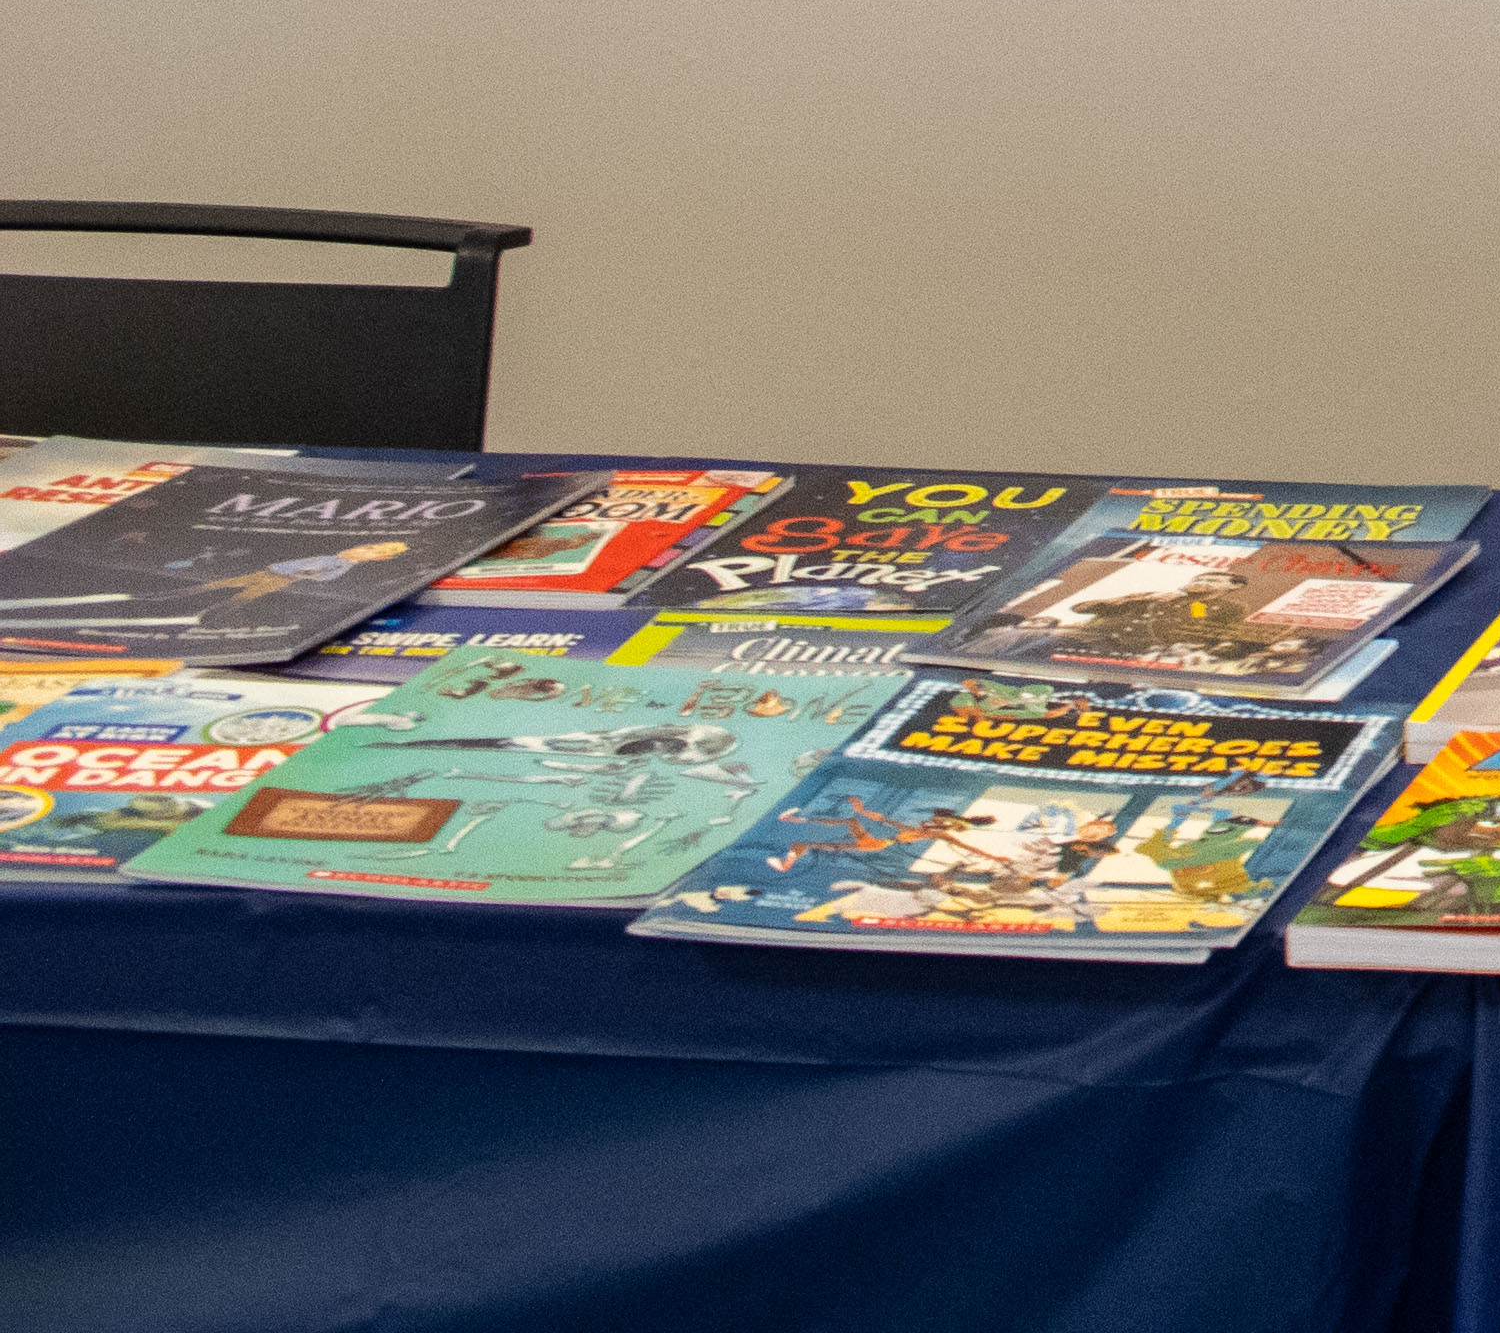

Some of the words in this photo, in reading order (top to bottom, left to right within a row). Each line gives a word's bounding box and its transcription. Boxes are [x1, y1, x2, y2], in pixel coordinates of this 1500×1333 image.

[205, 493, 487, 521] MARIO
[847, 480, 1067, 510] YOU
[856, 507, 991, 524] CAN
[1142, 498, 1423, 521] SPENDING
[1129, 514, 1415, 542] MONEY
[831, 549, 932, 564] THE
[932, 713, 1323, 758] SUPERHEROES
[1076, 711, 1211, 737] EVEN
[901, 731, 1042, 762] MAKE
[1067, 748, 1322, 778] MISTAKES
